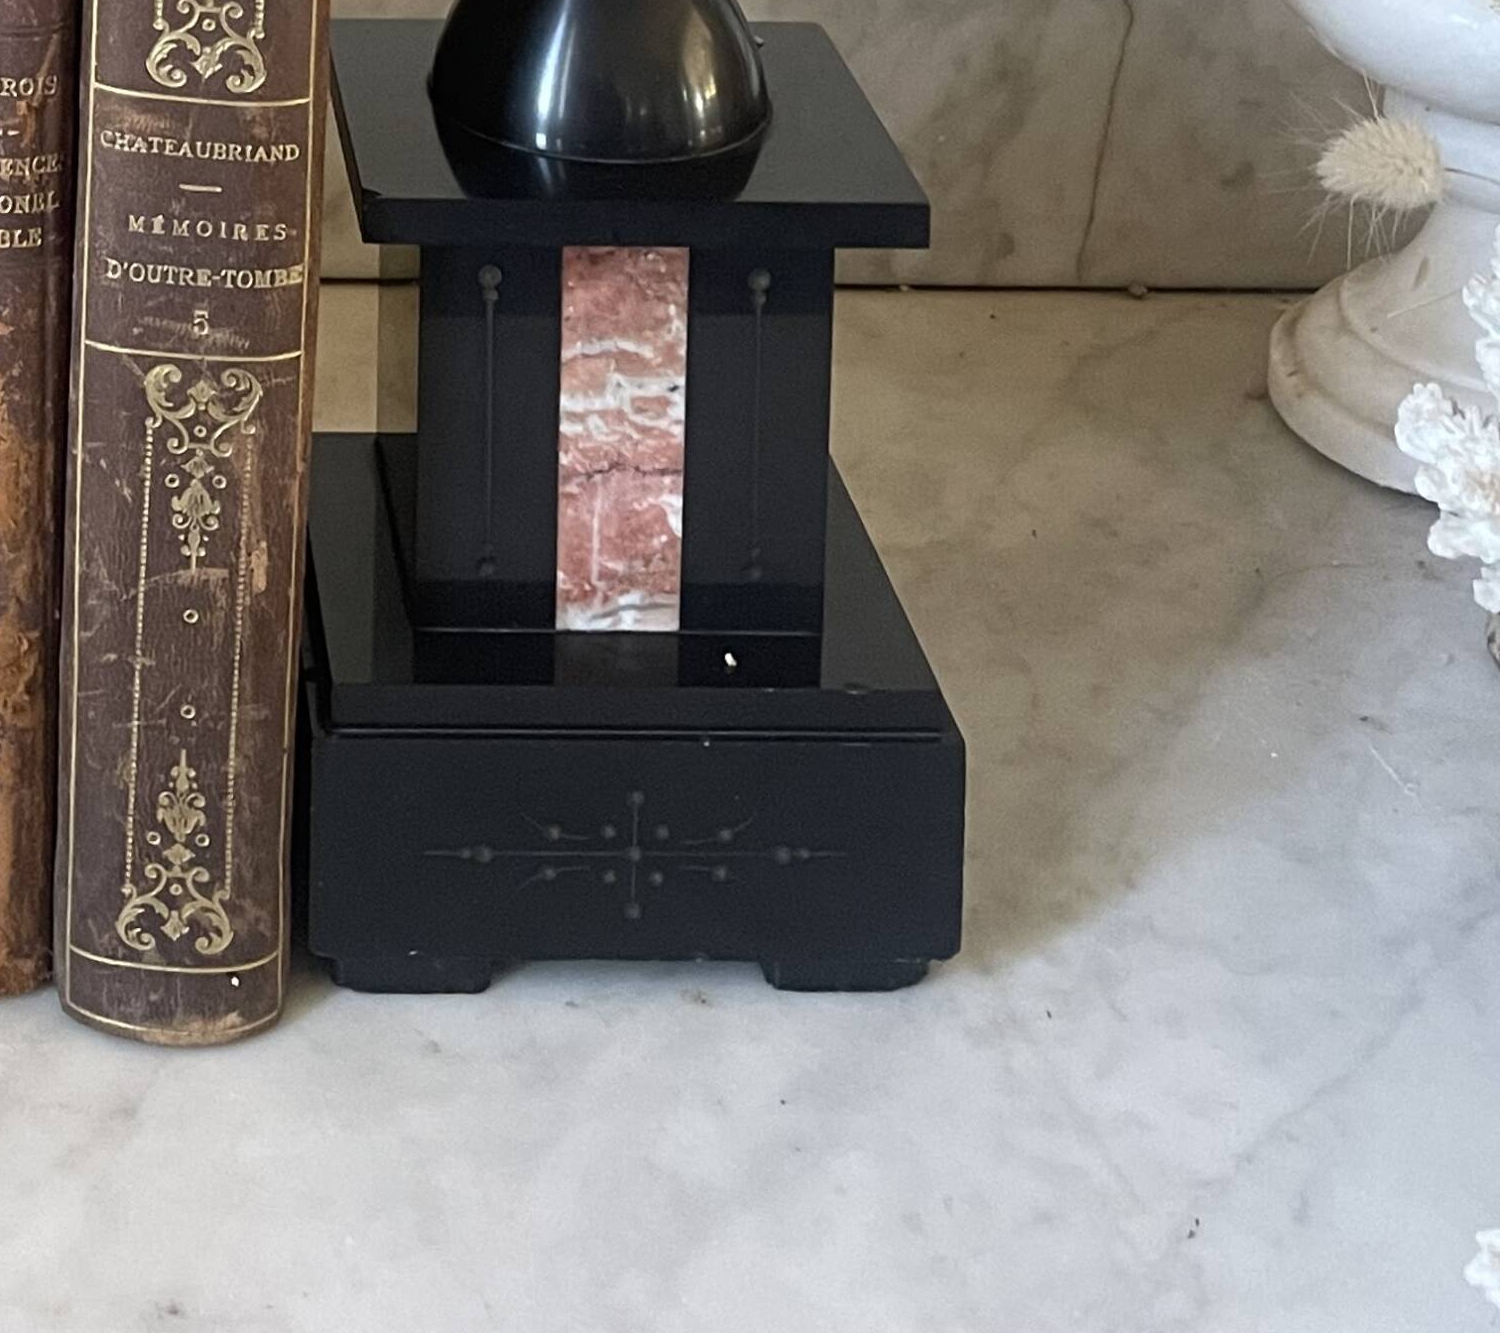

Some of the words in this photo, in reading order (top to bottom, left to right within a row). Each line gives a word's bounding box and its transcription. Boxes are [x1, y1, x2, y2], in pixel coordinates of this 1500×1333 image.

[100, 129, 301, 162] CHATEAUBRIAND
[103, 257, 304, 290] D'OUTRE-TOMBE
[192, 310, 210, 336] 5
